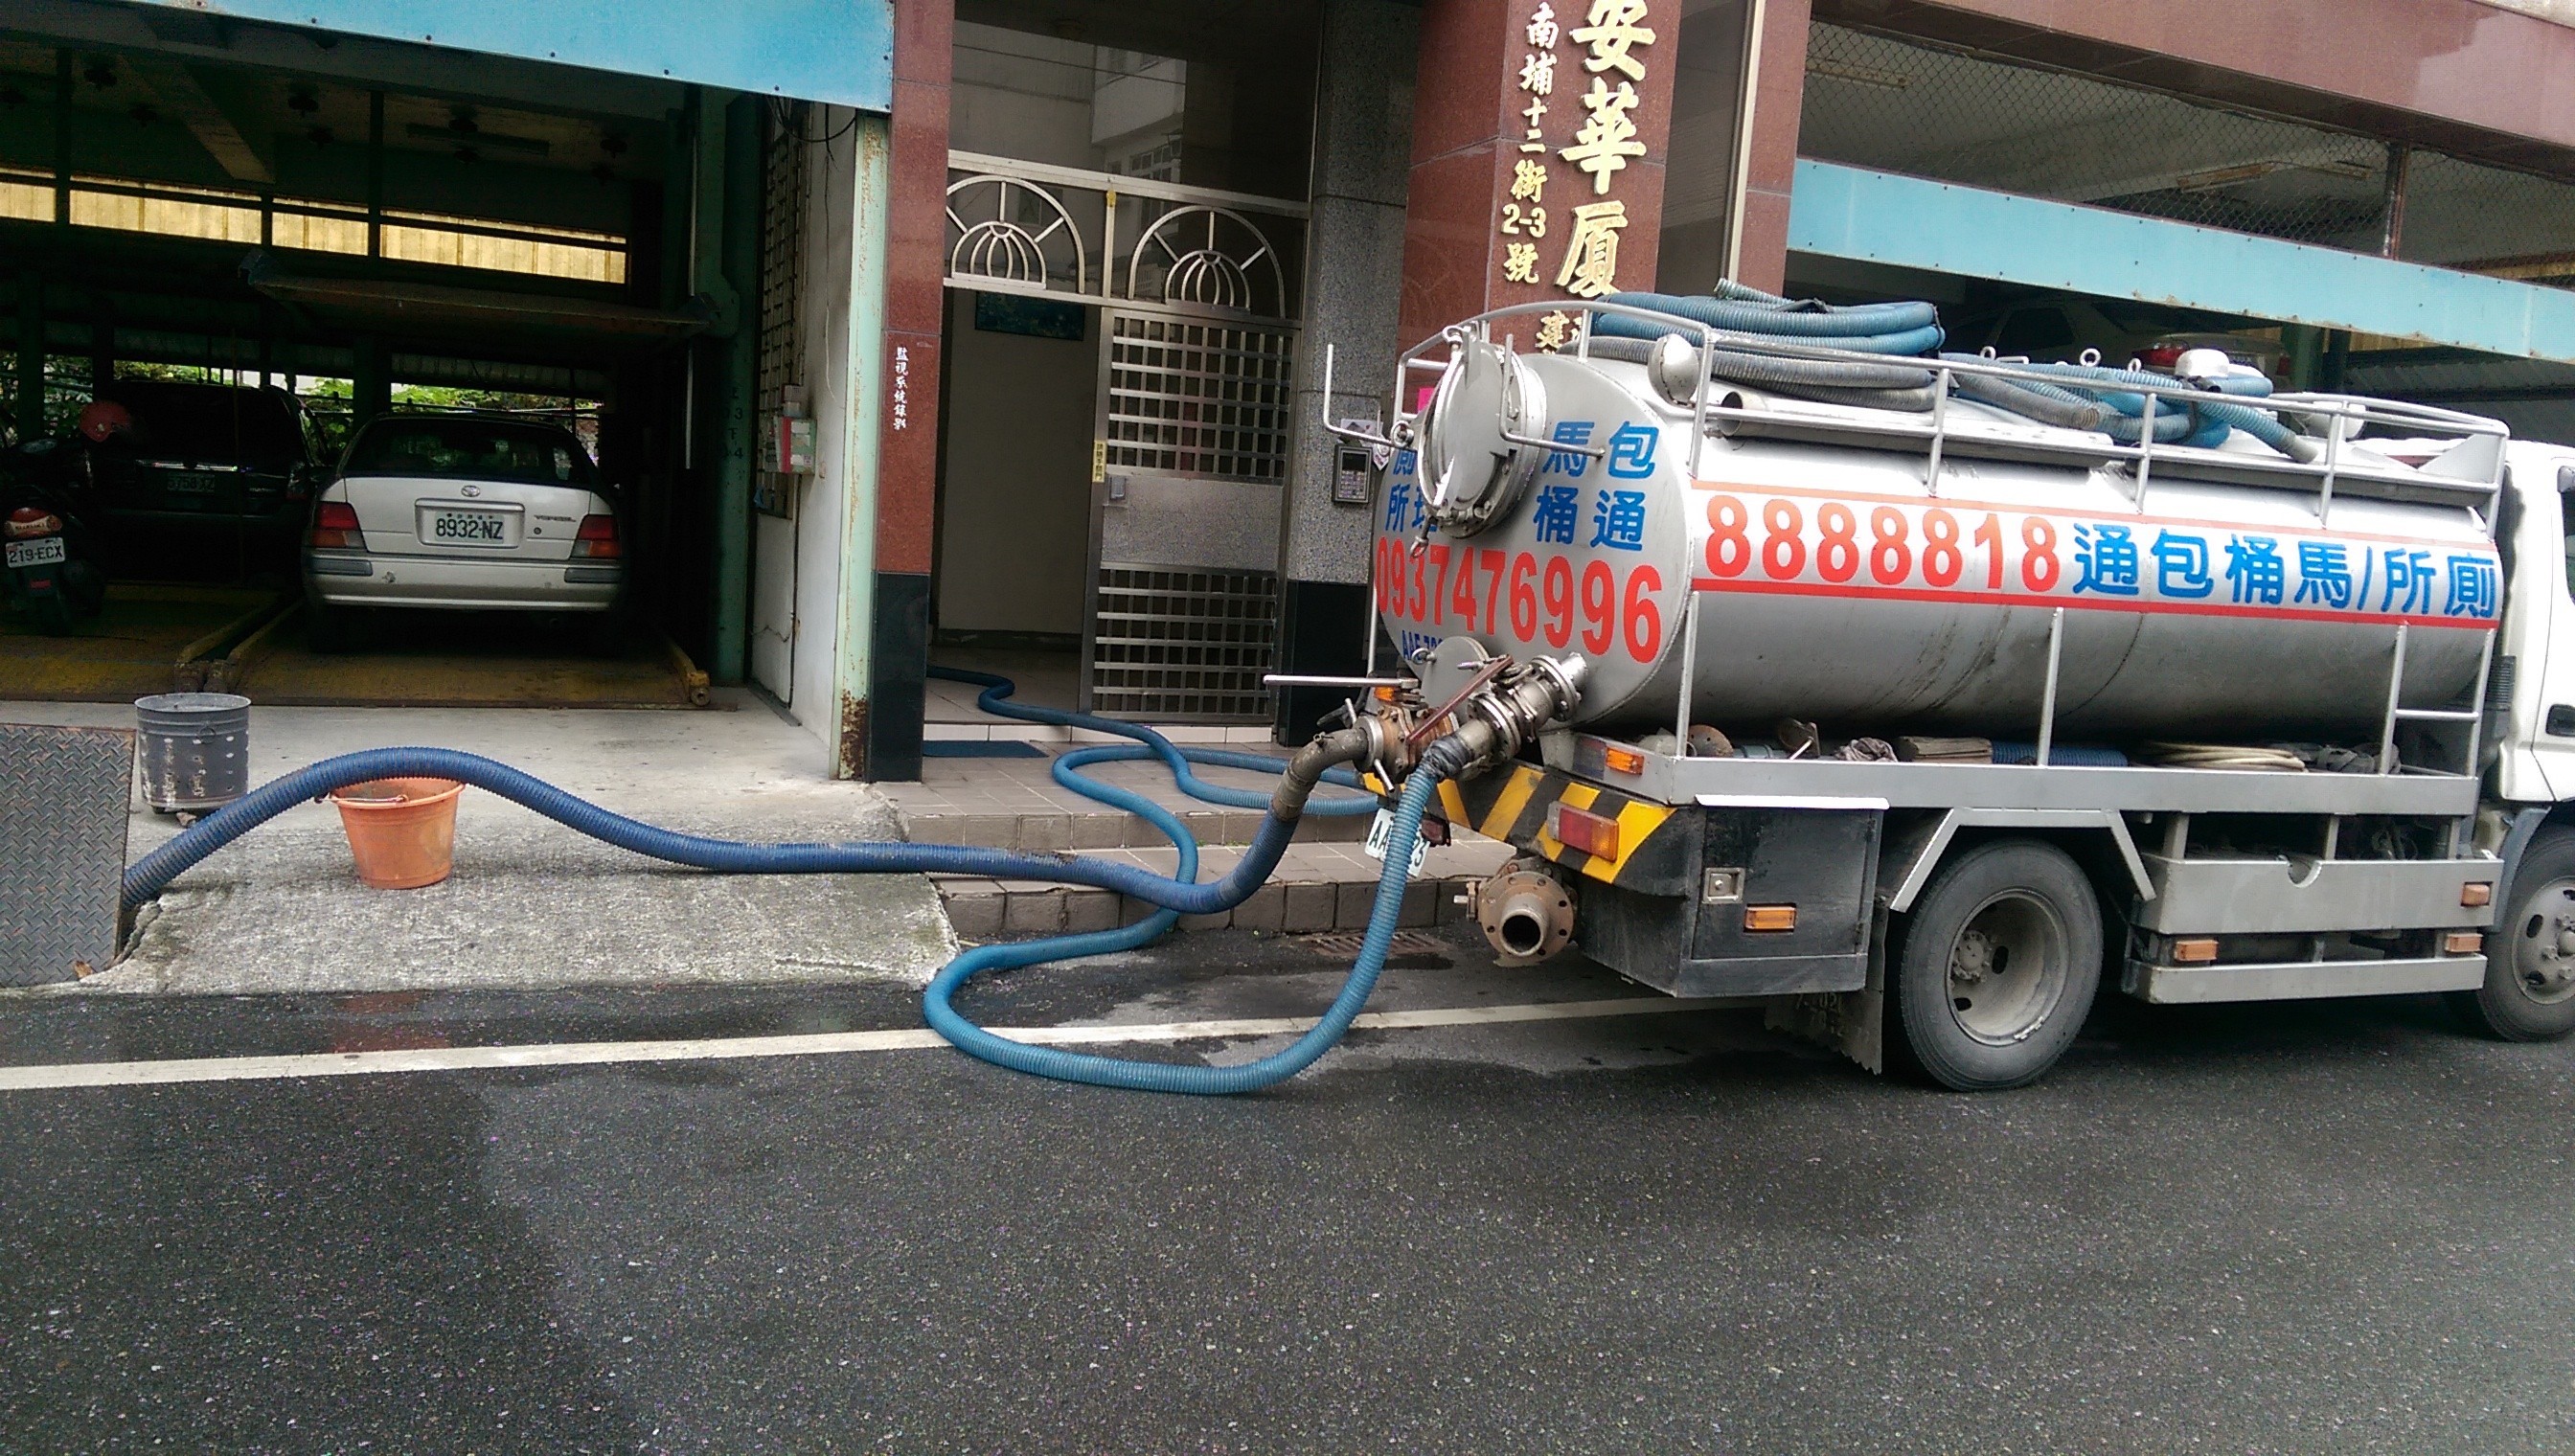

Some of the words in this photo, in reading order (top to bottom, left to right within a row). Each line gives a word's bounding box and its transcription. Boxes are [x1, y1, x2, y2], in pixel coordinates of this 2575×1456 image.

[9, 545, 63, 563] 219-ECX
[436, 518, 503, 539] 8932-NZ
[1705, 494, 2061, 593] 8888818
[1376, 536, 1663, 664] 0937476996
